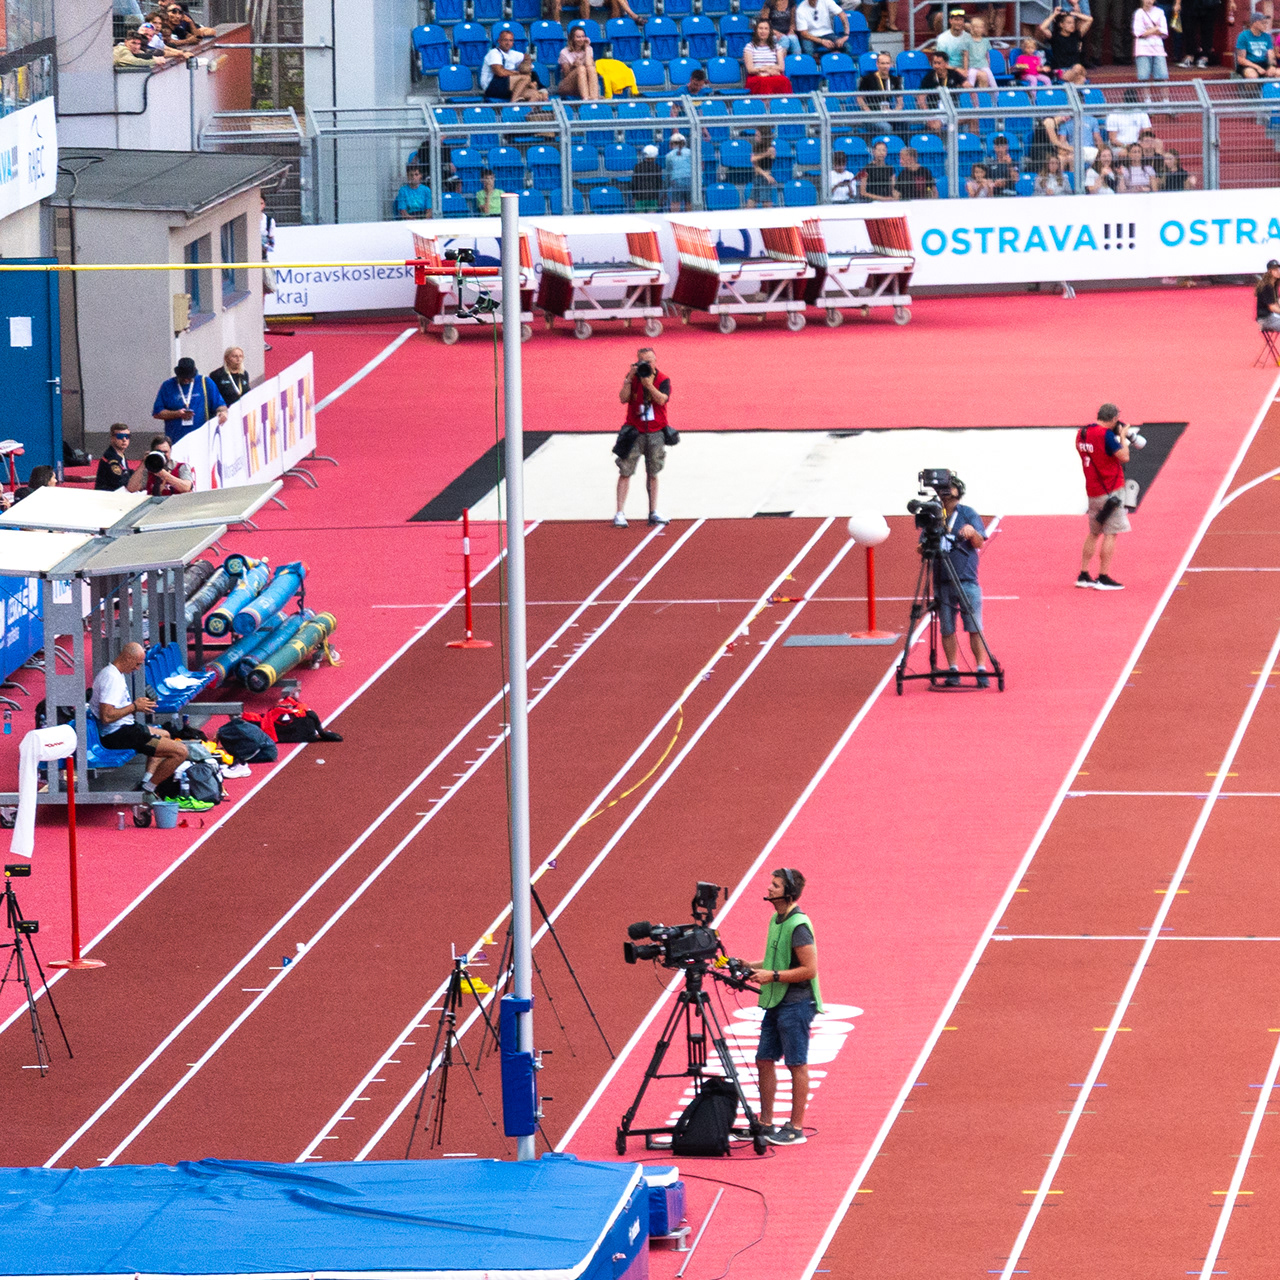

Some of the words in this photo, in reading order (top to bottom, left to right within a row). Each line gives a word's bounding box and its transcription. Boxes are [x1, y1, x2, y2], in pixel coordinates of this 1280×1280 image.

[920, 222, 1136, 256] OSTRAVA!!!
[275, 264, 414, 284] Moravskoslezsk
[275, 288, 308, 308] kraj
